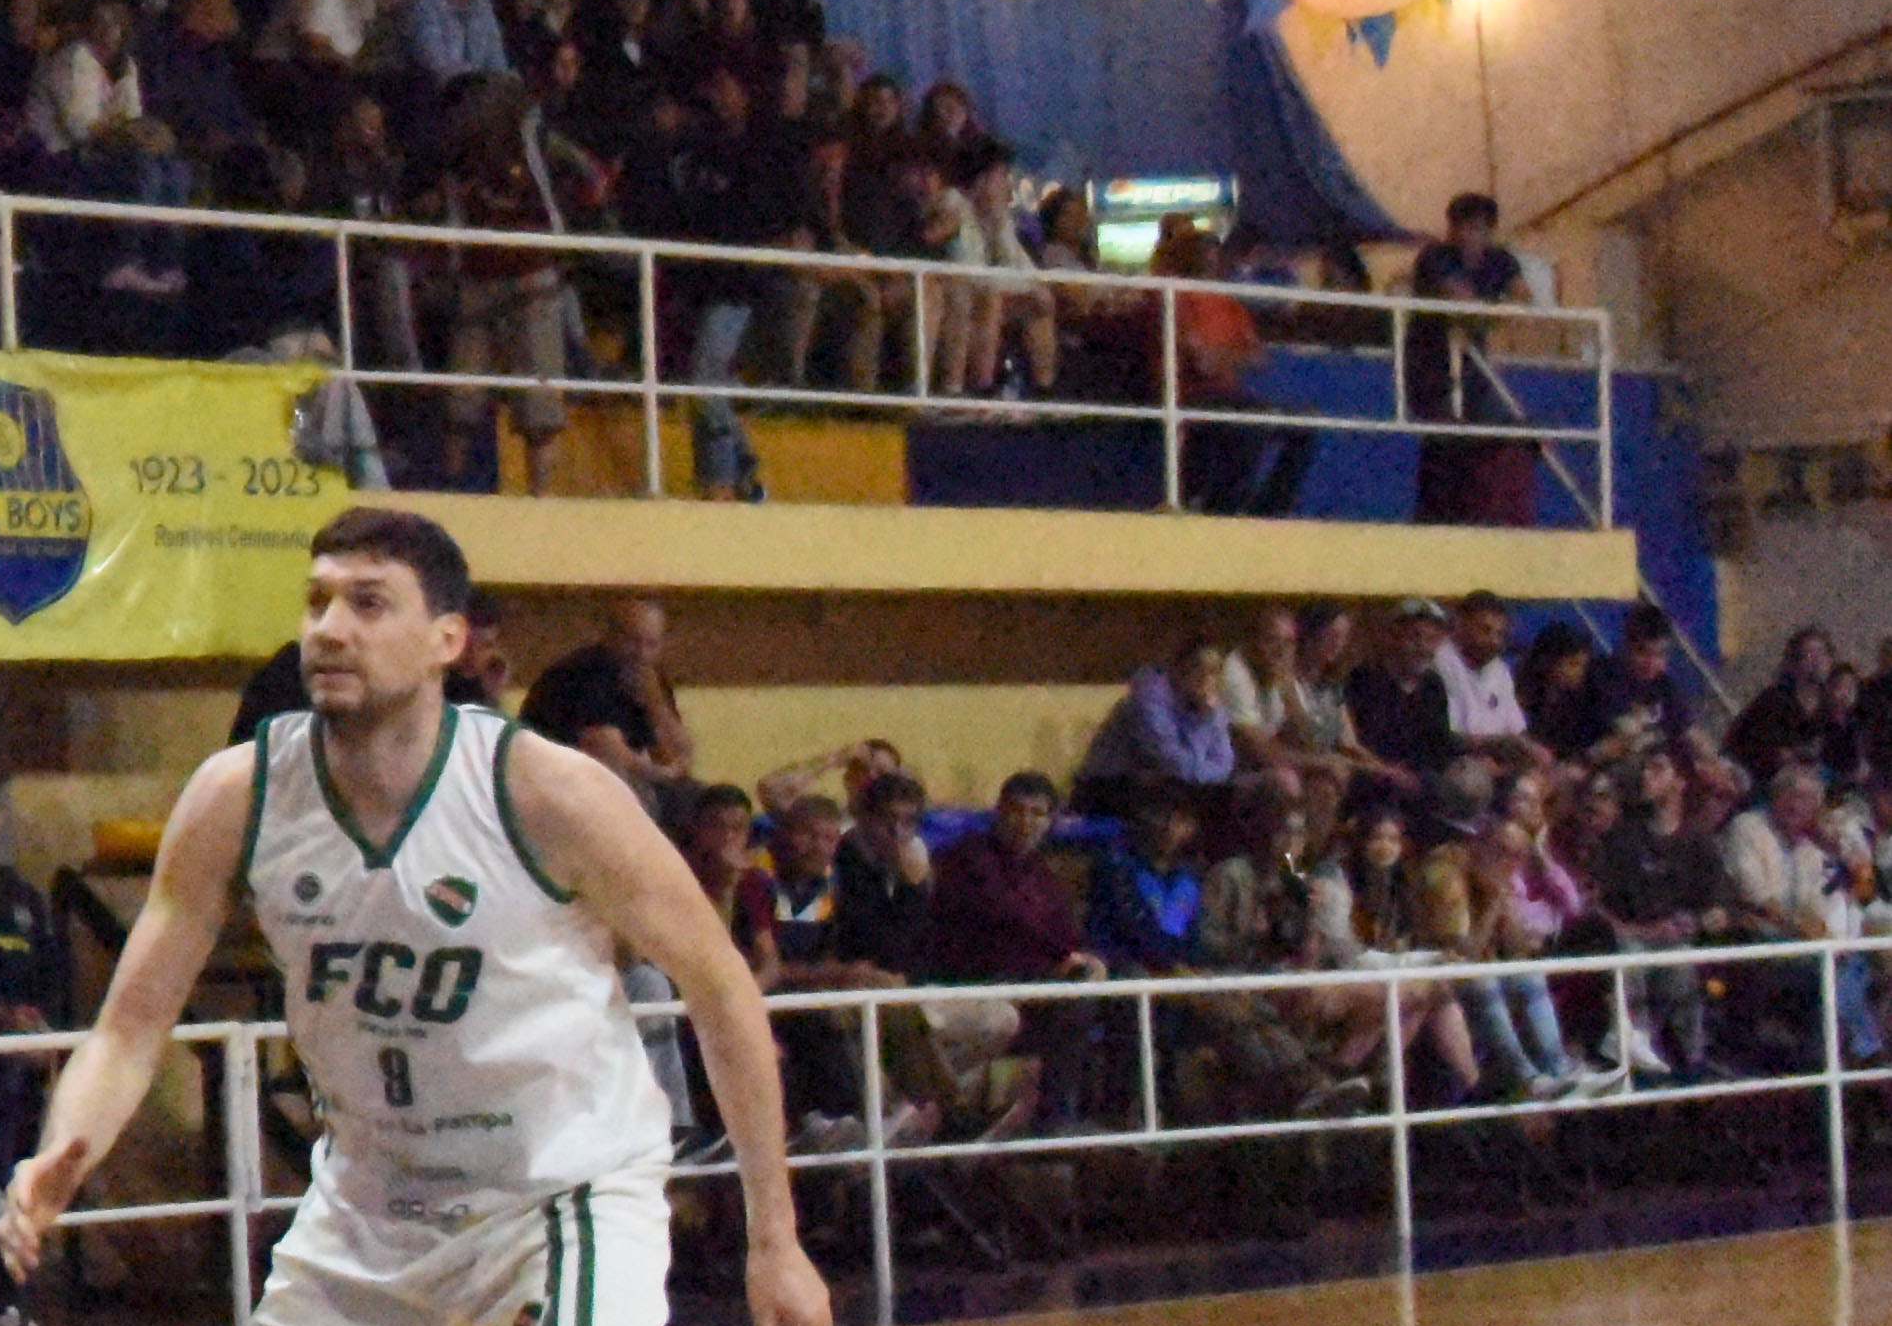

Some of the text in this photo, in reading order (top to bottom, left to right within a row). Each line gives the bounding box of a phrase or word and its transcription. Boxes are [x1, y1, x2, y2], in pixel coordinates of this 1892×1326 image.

[129, 455, 205, 495] 1923
[241, 456, 320, 496] 2023
[6, 495, 81, 532] BOYS
[305, 940, 484, 1024] FCO
